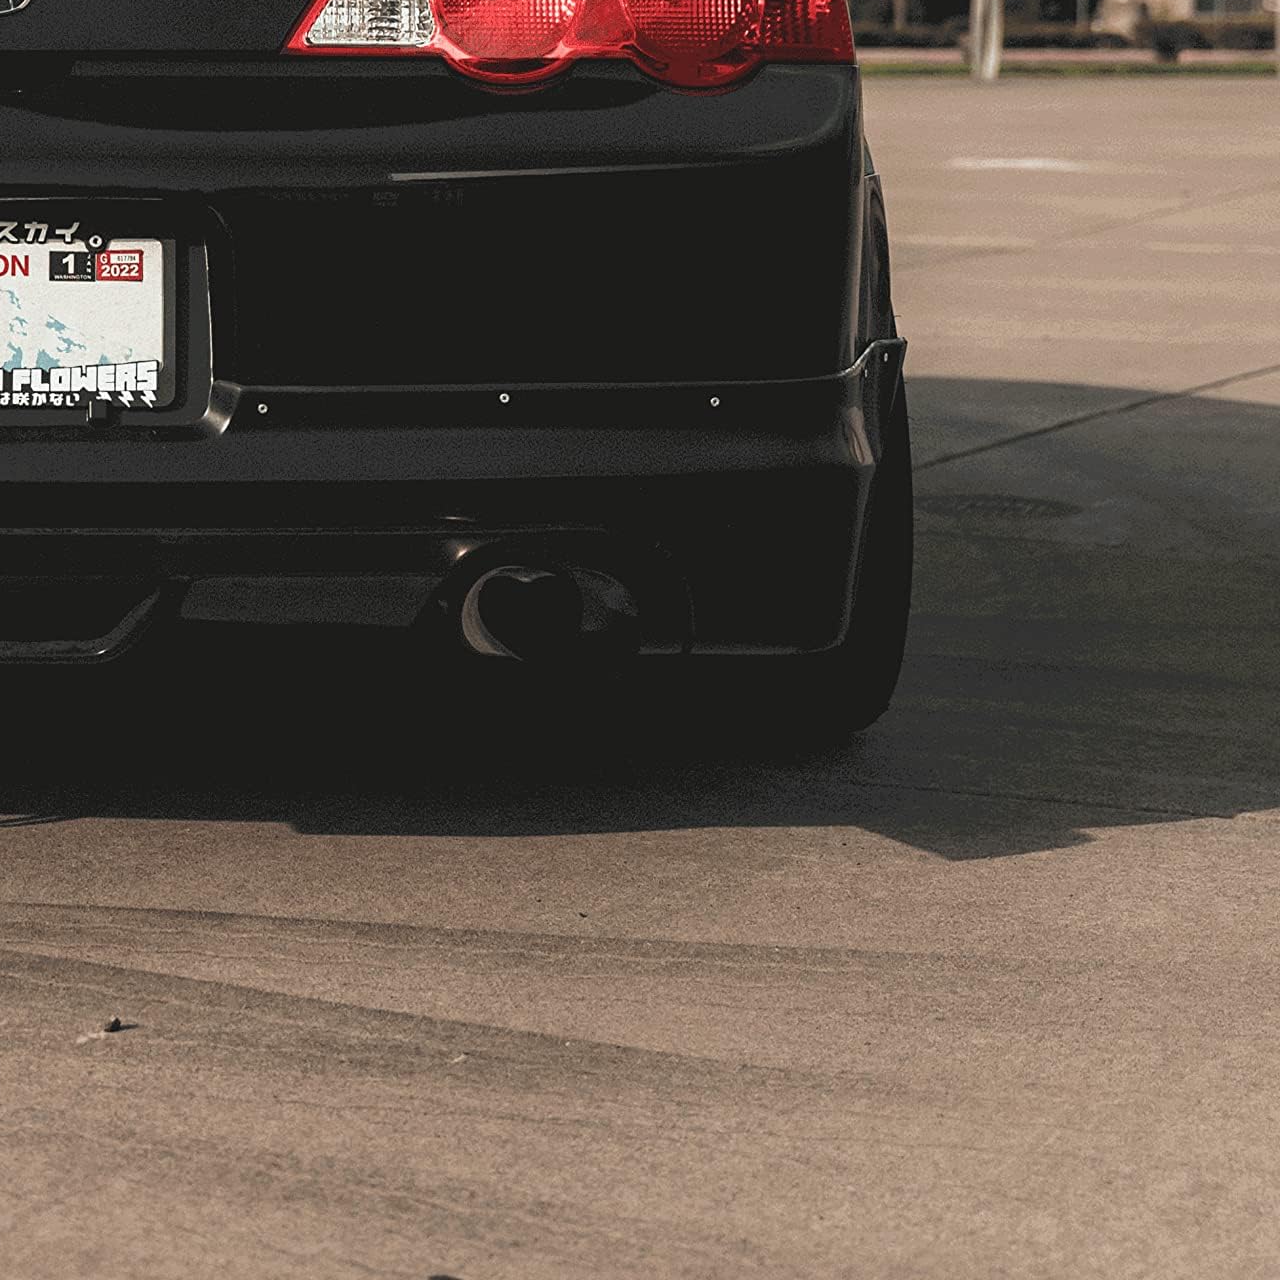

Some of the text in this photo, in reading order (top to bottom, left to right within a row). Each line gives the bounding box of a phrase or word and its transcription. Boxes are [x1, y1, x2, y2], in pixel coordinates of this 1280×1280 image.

[62, 253, 75, 274] 1
[101, 264, 139, 277] 2022
[12, 360, 158, 392] FLOWERS
